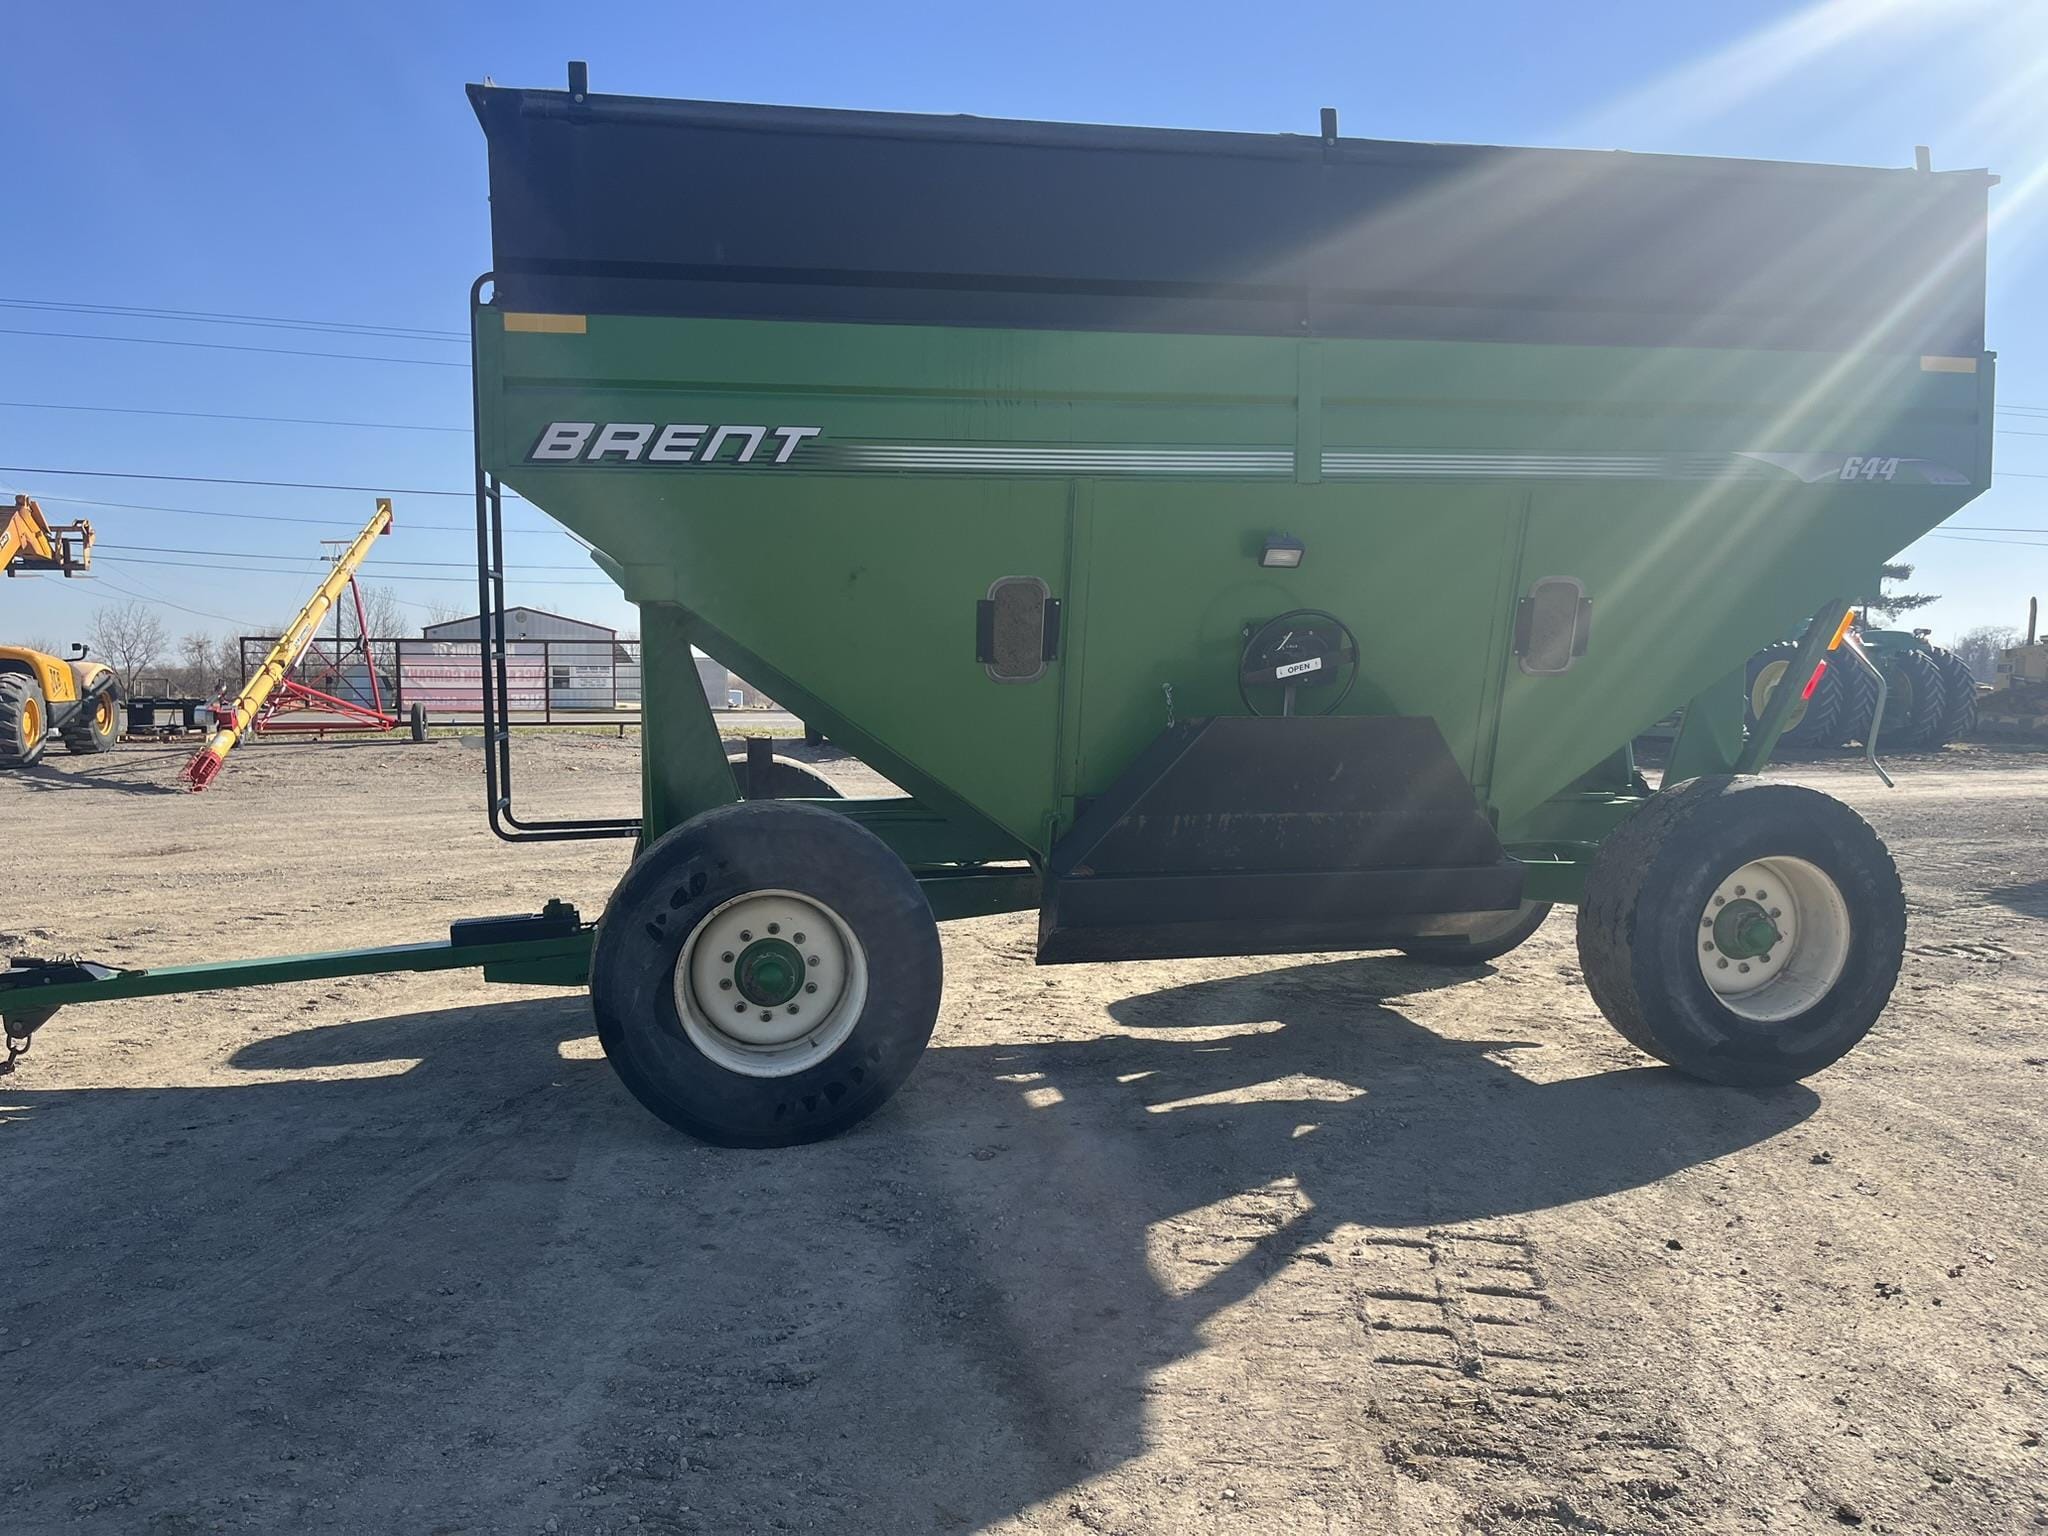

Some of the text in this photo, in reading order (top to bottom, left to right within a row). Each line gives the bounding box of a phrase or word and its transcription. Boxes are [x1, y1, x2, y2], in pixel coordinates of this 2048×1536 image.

[526, 421, 822, 464] BRENT
[1839, 456, 1899, 481] 644
[1287, 663, 1310, 674] OPEN
